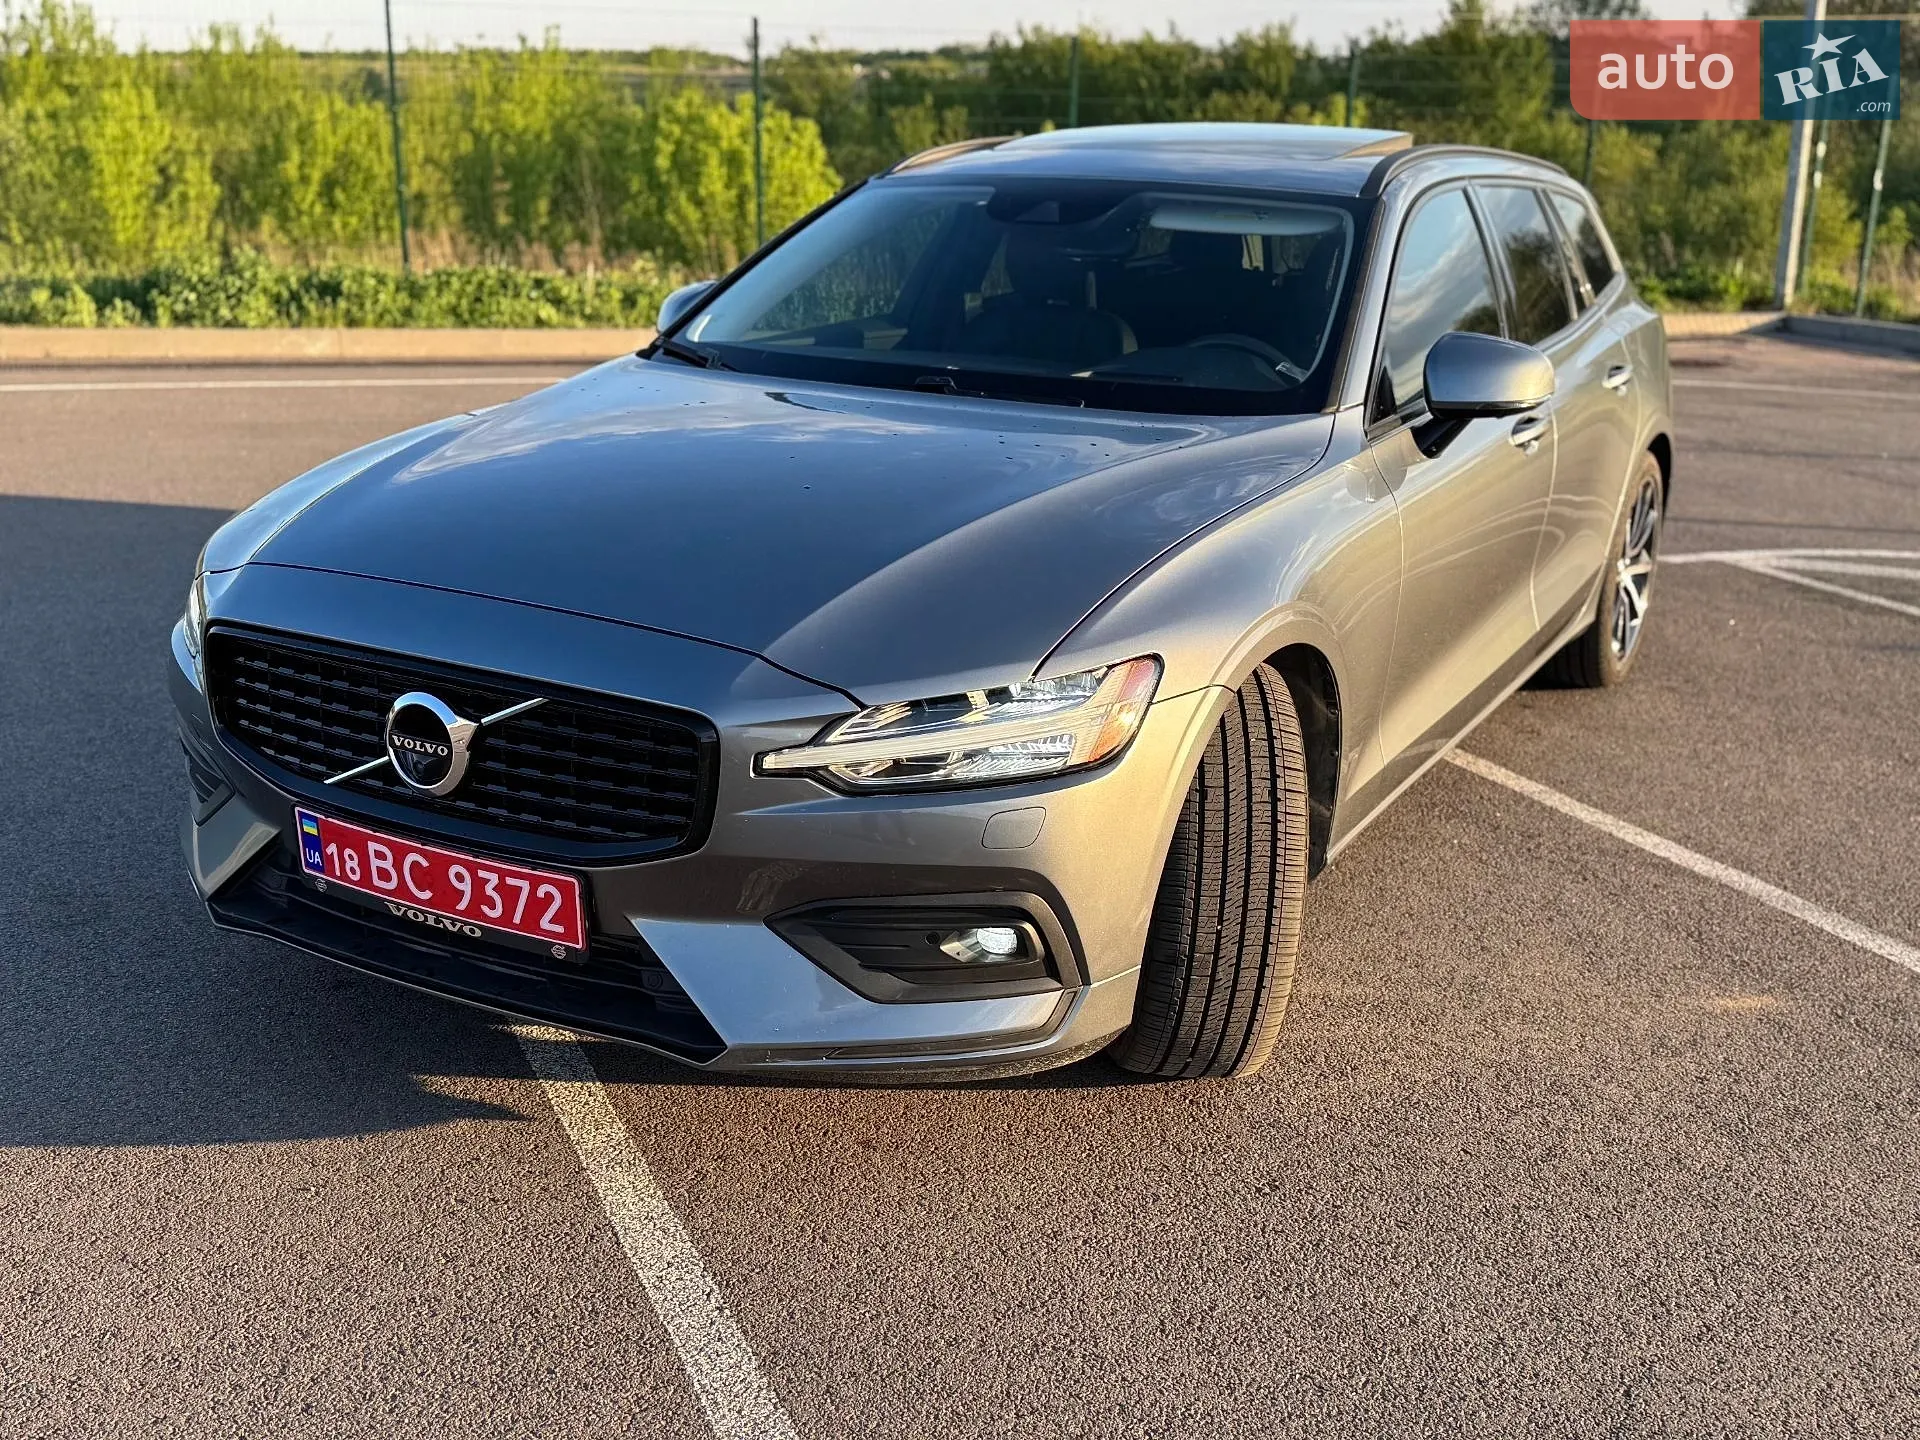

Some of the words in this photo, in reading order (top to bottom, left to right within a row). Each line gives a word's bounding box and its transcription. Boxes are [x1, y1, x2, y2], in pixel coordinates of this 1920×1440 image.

[391, 734, 448, 756] VOLVO
[305, 848, 322, 867] UA
[325, 842, 361, 882] 18
[367, 841, 433, 900] BC
[449, 864, 565, 933] 9372
[384, 901, 482, 938] VOLVO
